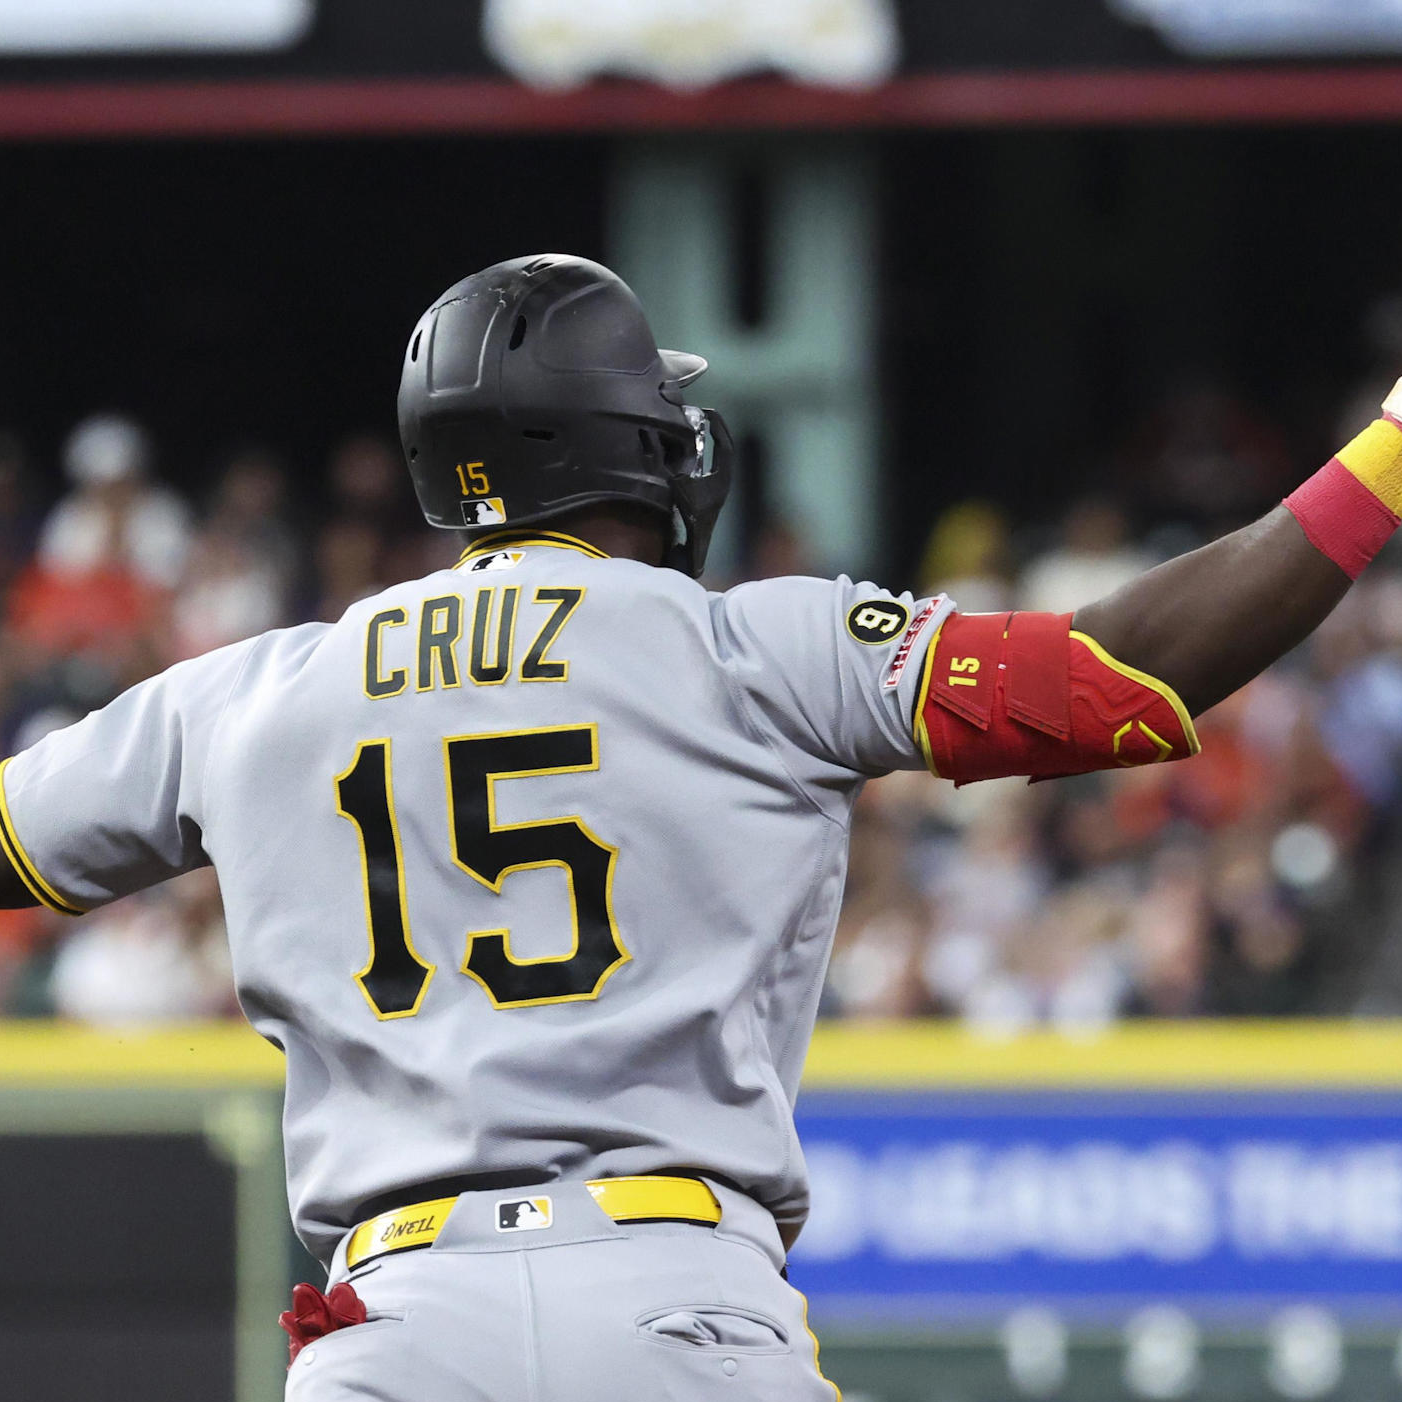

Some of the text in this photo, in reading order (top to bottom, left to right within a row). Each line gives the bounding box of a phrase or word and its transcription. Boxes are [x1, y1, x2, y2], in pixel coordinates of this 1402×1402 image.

[455, 461, 491, 496] 15
[854, 606, 902, 634] 9
[364, 584, 587, 699] CRUZ
[948, 656, 981, 687] 15
[335, 722, 633, 1021] 15
